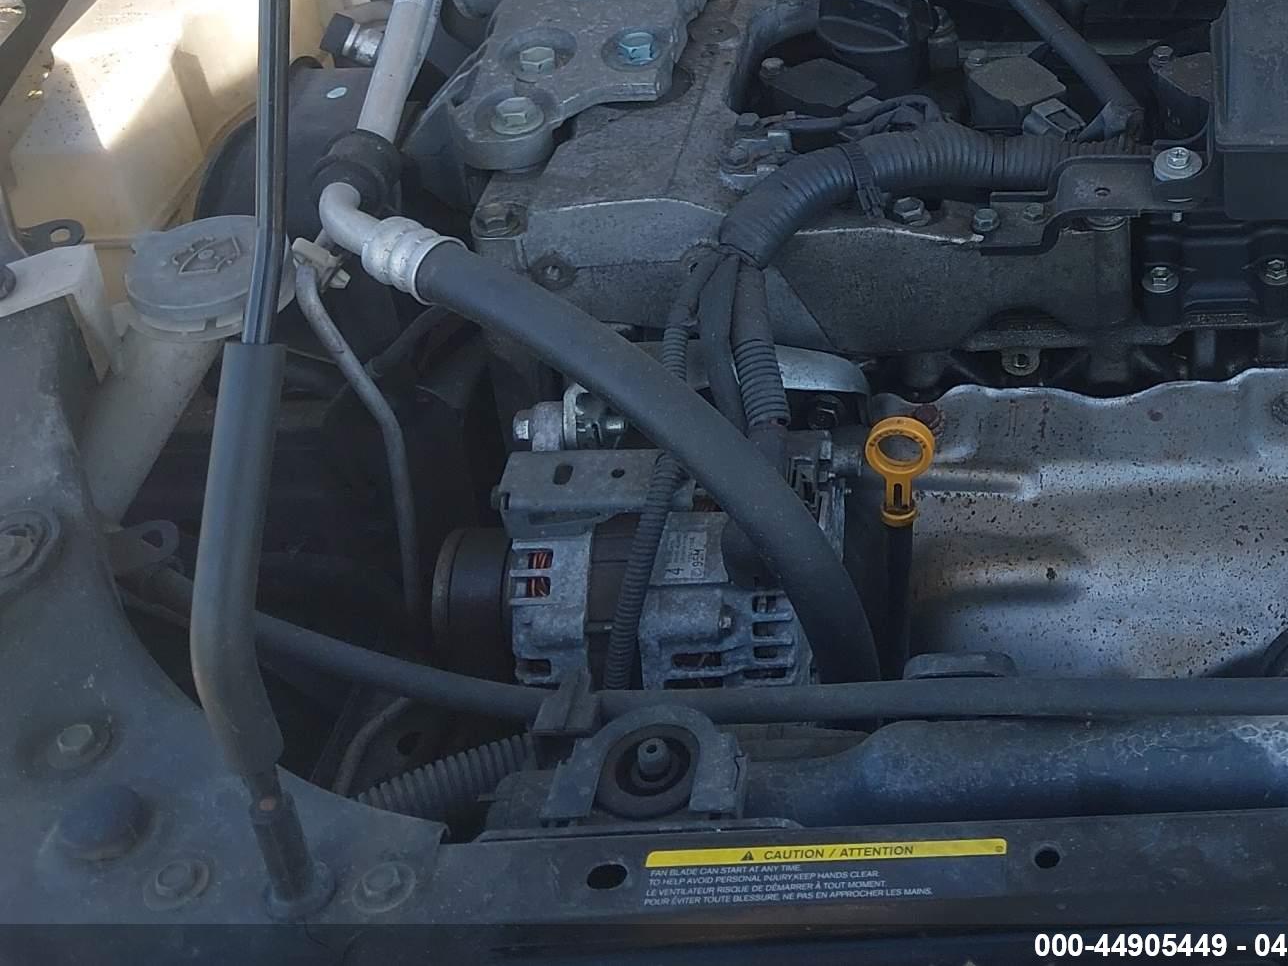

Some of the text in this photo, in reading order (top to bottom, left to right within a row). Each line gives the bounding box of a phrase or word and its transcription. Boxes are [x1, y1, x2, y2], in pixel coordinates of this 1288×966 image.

[764, 846, 914, 860] CAUTION / ATTENTION
[649, 878, 660, 886] TO
[715, 875, 761, 883] PERSONAL
[817, 871, 848, 880] HANDS
[650, 869, 668, 877] FAN
[669, 868, 697, 877] BLADE
[700, 867, 719, 875] CAN
[719, 866, 746, 874] START
[748, 865, 758, 873] AT
[760, 865, 779, 873] ANY
[646, 889, 656, 897] LE
[660, 886, 715, 896] VENTILATEUR
[717, 885, 748, 893] RISQUE
[751, 884, 762, 892] DE
[765, 882, 813, 891] DÉMARRER
[824, 881, 845, 889] TOUT
[644, 897, 670, 906] POUR
[671, 895, 701, 905] ÉVITER
[703, 895, 731, 903] TOUTE
[782, 893, 796, 901] NE
[797, 892, 814, 900] PAS
[815, 891, 828, 899] EN
[829, 889, 883, 899] APPROCHER
[886, 888, 902, 896] LES
